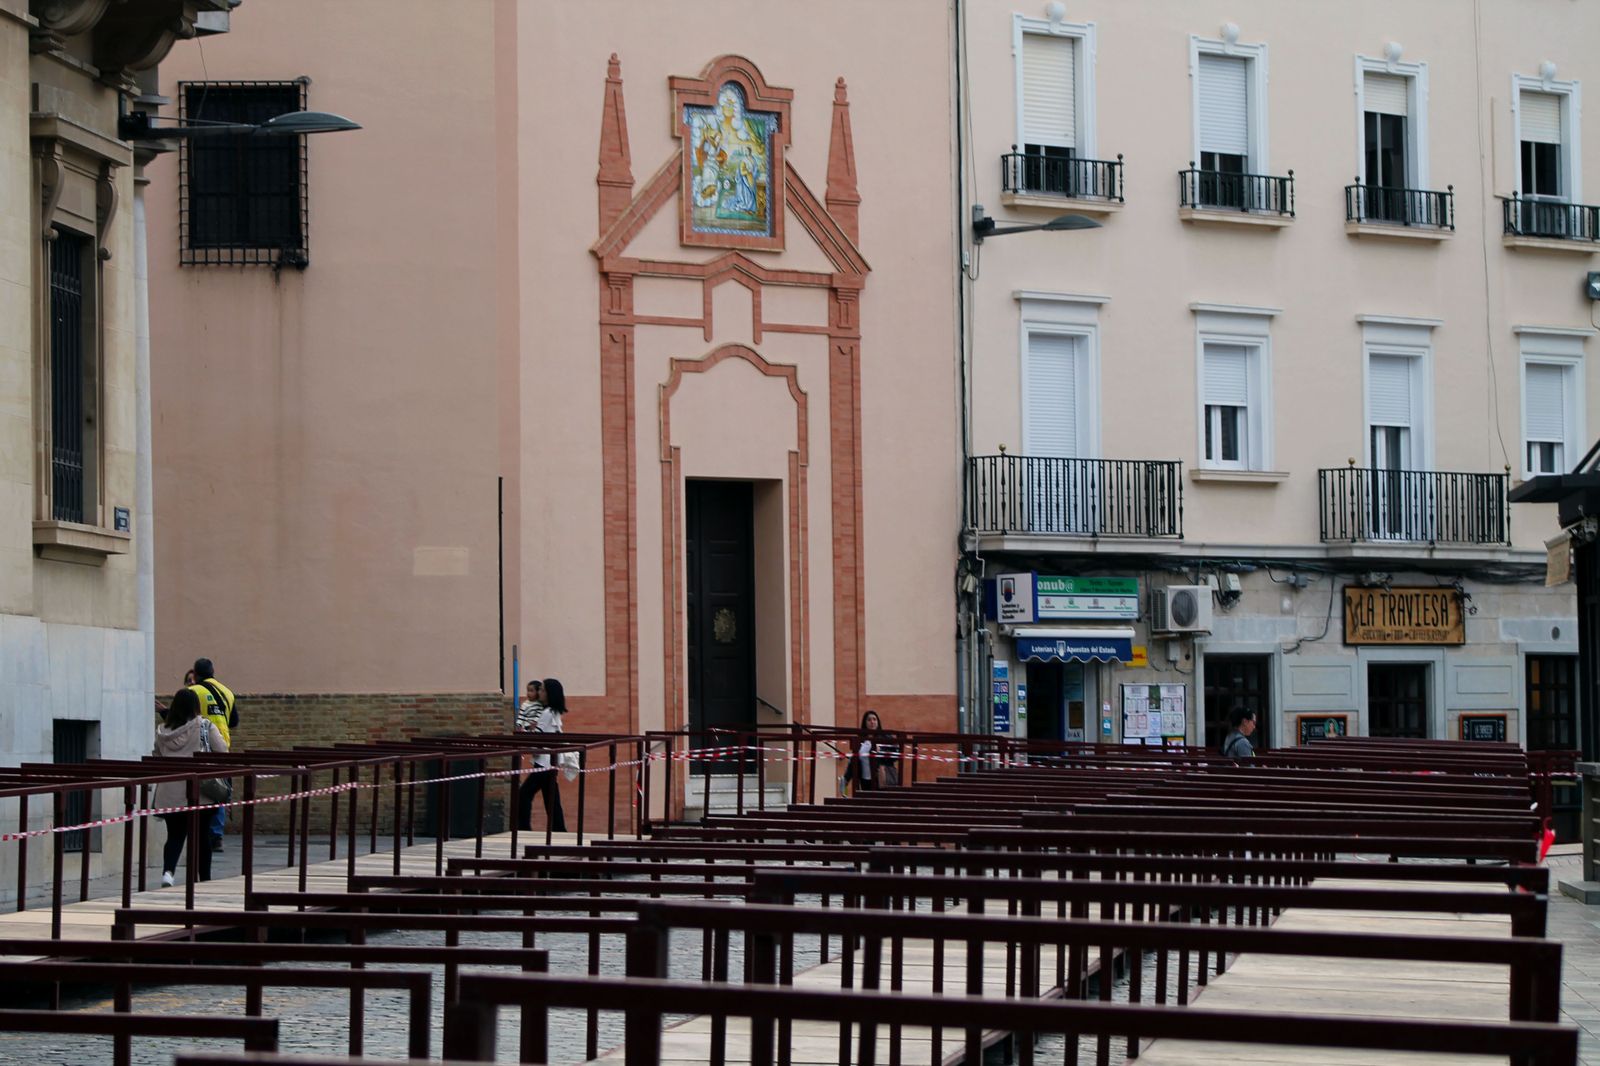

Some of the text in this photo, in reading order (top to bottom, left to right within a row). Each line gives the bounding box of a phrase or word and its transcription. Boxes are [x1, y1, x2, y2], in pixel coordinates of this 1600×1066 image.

[1360, 593, 1449, 627] LA TRAVIESA
[1067, 646, 1090, 654] Apuestas
